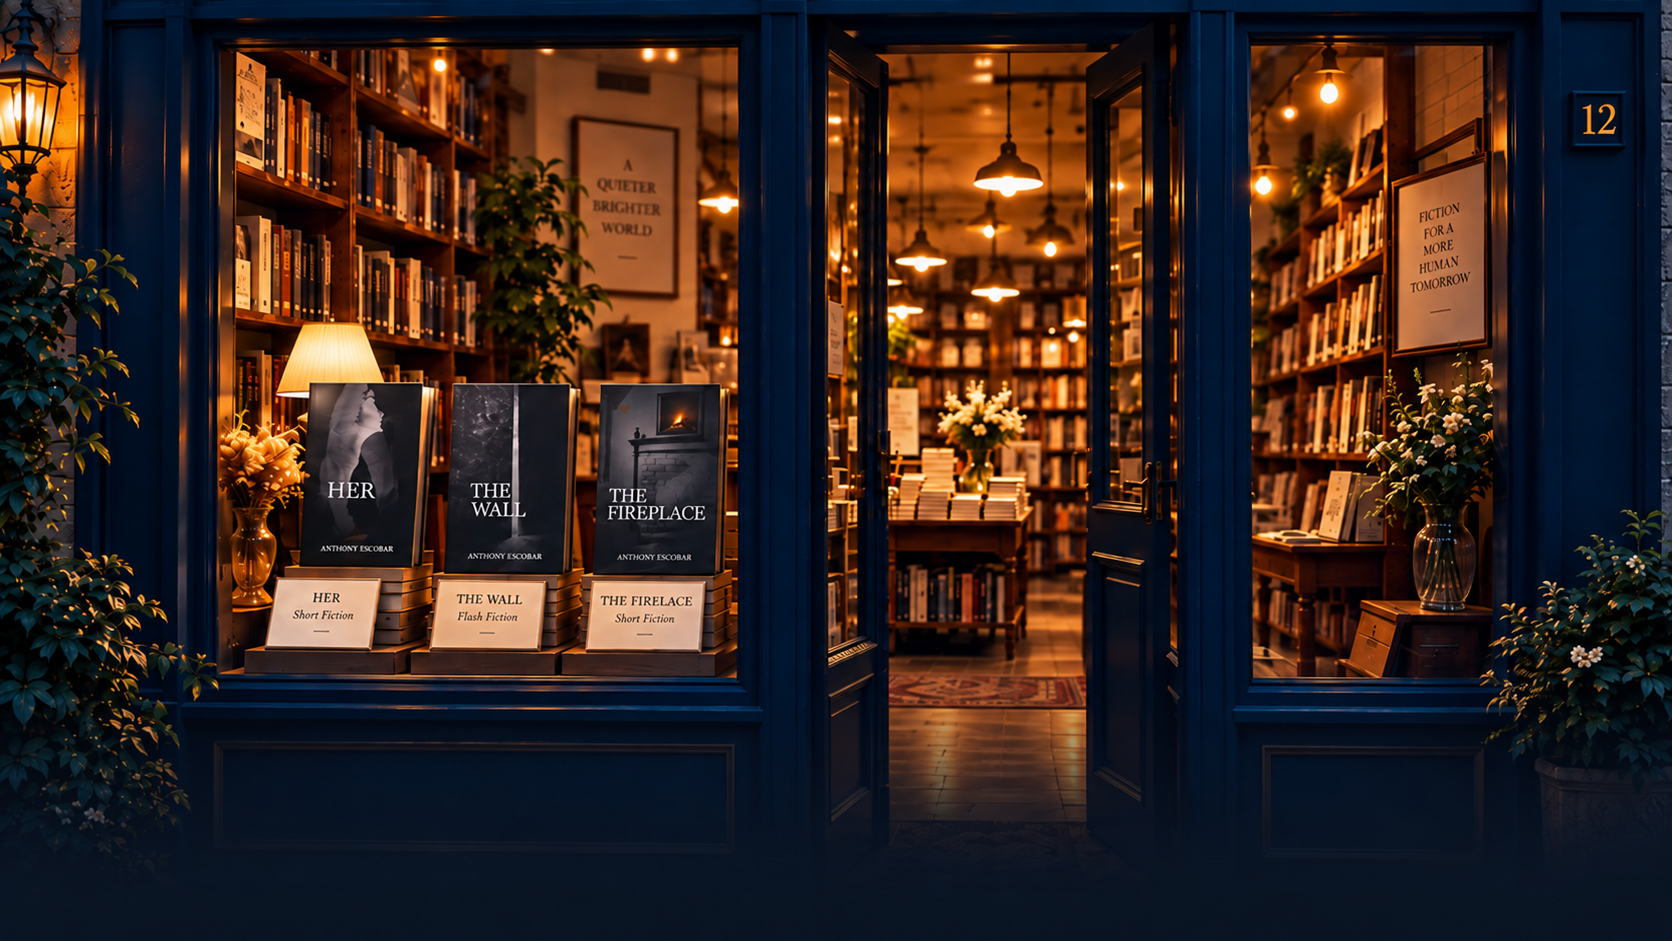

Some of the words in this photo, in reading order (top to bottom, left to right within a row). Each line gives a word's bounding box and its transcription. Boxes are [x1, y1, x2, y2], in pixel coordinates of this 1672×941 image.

[1582, 103, 1617, 135] 12
[623, 159, 633, 172] A
[597, 177, 656, 194] QUIETER
[593, 200, 661, 216] BRIGHTER
[1419, 202, 1460, 223] FICTION
[601, 222, 653, 236] WORLD
[1424, 225, 1445, 240] FOR
[1446, 222, 1454, 235] A
[1423, 239, 1454, 256] MORE
[1419, 255, 1459, 274] HUMAN
[1410, 271, 1471, 293] TOMORROW
[327, 481, 376, 499] HER
[470, 482, 511, 499] THE
[609, 488, 647, 503] THE
[471, 501, 527, 518] WALL
[607, 505, 706, 521] FIREPLACE
[320, 545, 358, 553] ANTHONY
[359, 545, 394, 553] ESCOBAR
[467, 552, 506, 560] ANTHONY
[507, 552, 543, 561] ESCOBAR
[617, 553, 655, 561] ANTHONY
[656, 554, 692, 562] ESCOBAR
[312, 592, 341, 603] HER
[456, 594, 483, 605] THE
[487, 594, 523, 605] WALL
[600, 595, 627, 606] THE
[631, 596, 693, 607] FIRELACE
[292, 609, 319, 620] Short
[321, 610, 354, 620] Fiction
[457, 611, 484, 622] Flash
[485, 611, 518, 622] Fiction
[614, 613, 640, 624] Short
[643, 613, 675, 624] Fiction
